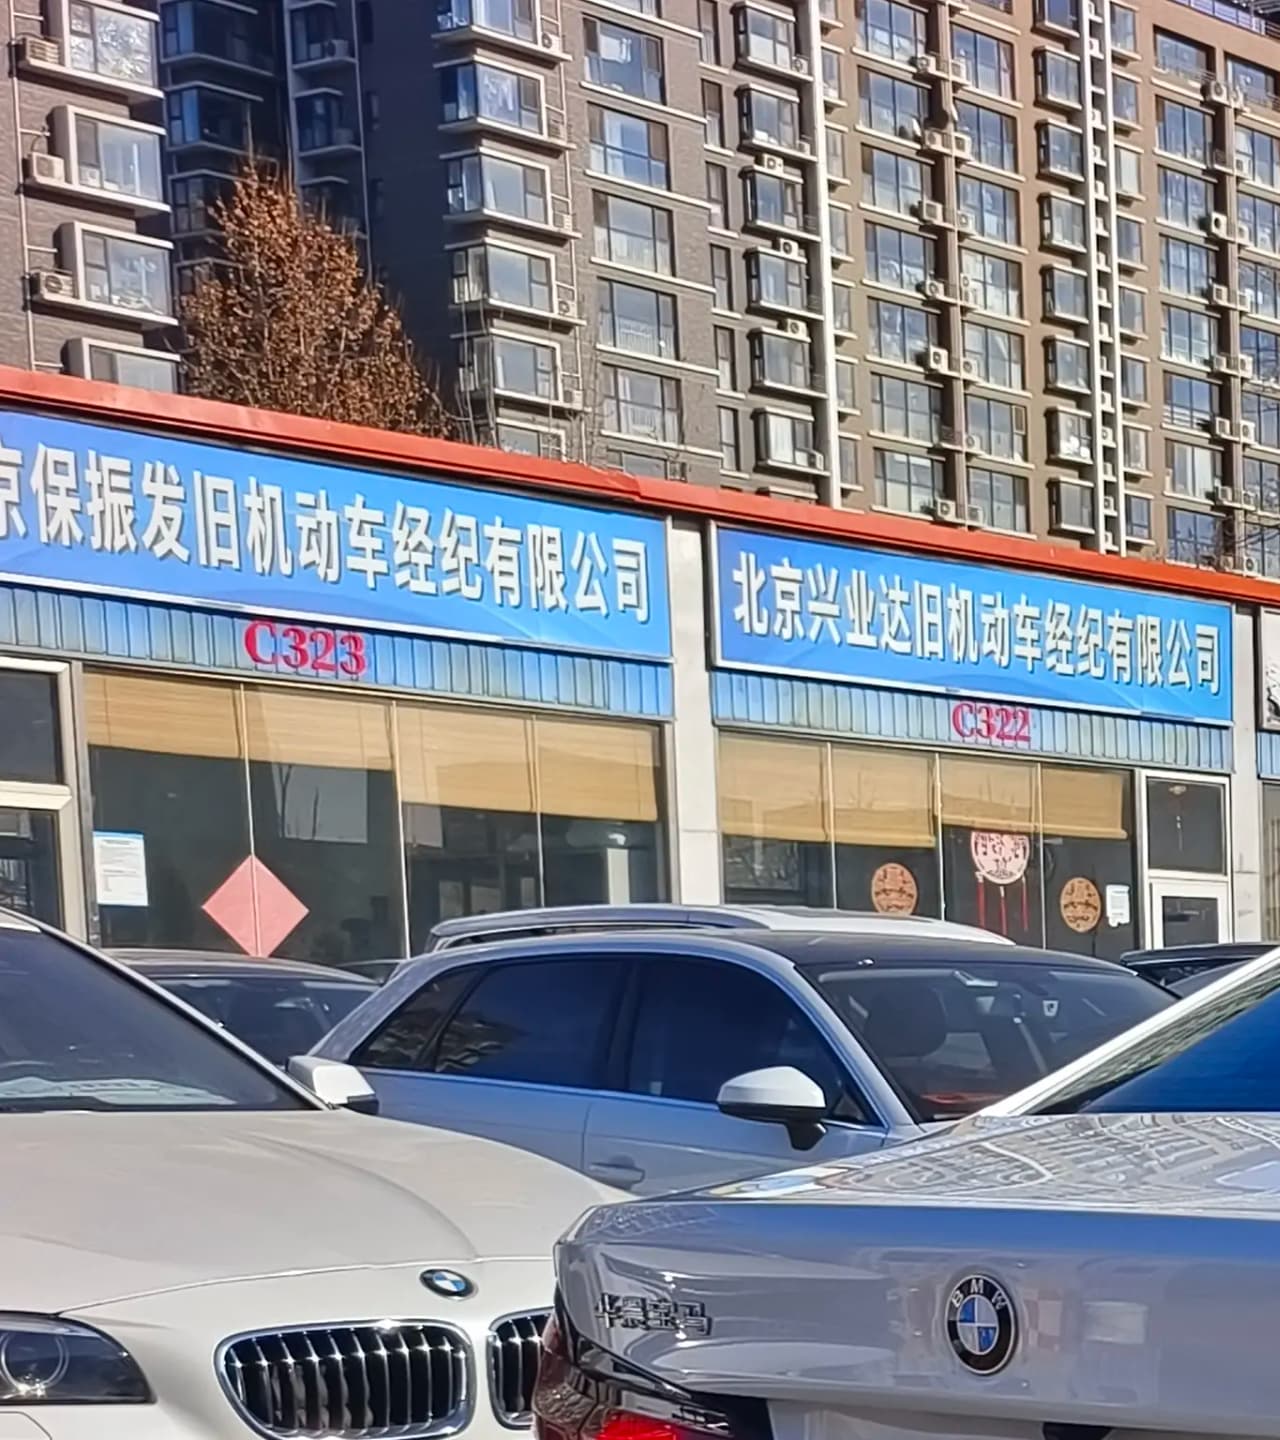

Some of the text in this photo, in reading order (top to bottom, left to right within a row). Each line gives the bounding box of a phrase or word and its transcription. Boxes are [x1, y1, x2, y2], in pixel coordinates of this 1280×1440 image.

[733, 550, 1220, 695] 北京兴业达旧机动车经纪有限公司
[243, 619, 367, 676] C323
[951, 701, 1033, 743] C322
[951, 1278, 1009, 1310] BMW
